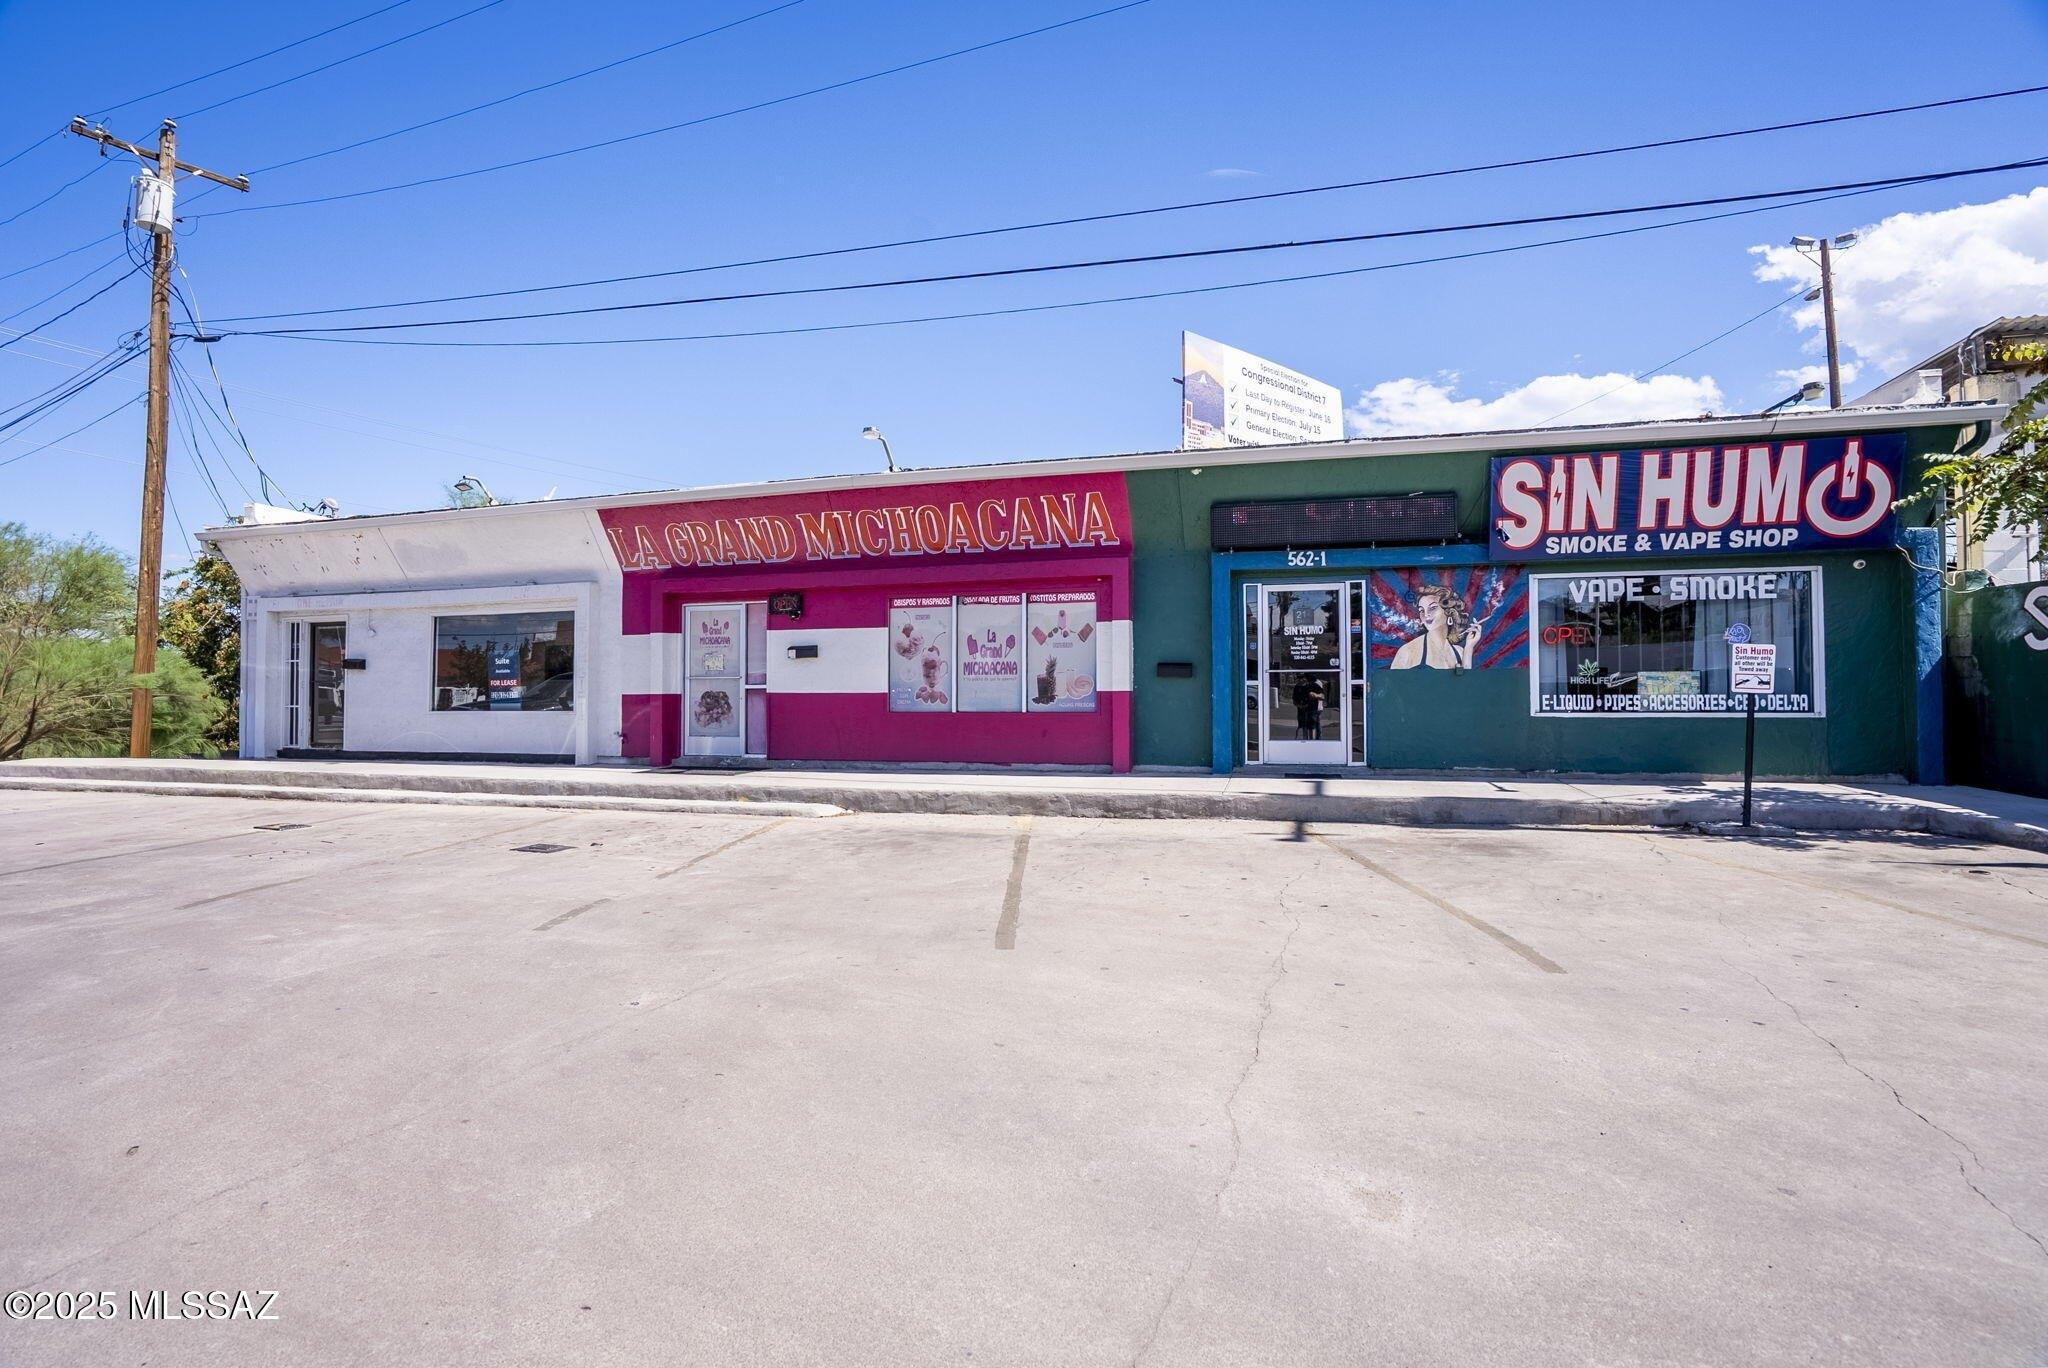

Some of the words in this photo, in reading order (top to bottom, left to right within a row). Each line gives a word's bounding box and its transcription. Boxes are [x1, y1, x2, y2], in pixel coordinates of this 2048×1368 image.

[1260, 364, 1280, 377] Special
[1280, 371, 1301, 384] Election
[1241, 367, 1296, 395] Congressional
[1297, 387, 1322, 404] District
[1322, 396, 1326, 405] 7
[1245, 389, 1260, 400] Last
[1261, 393, 1273, 406] Day
[1273, 398, 1280, 407] to
[1308, 409, 1323, 421] June
[1246, 404, 1270, 420] Primary
[1272, 412, 1296, 427] Election:
[1299, 420, 1312, 434] July
[1314, 425, 1321, 434] 15
[1246, 421, 1272, 436] General
[1497, 456, 1621, 550] SIN
[1638, 441, 1892, 537] HUMO
[607, 526, 671, 572] LA
[665, 516, 797, 567] GRAND
[796, 491, 1121, 561] MICHOACANA
[1545, 534, 1627, 556] SMOKE
[1634, 533, 1652, 552] &
[1660, 531, 1722, 551] VAPE
[1728, 528, 1799, 548] SHOP
[1288, 551, 1327, 567] 562-1
[1058, 592, 1095, 600] PREPARADOS
[1568, 577, 1645, 603] VAPE
[1669, 575, 1778, 601] SMOKE
[918, 598, 922, 606] Y
[922, 598, 950, 606] RASPADOS
[990, 596, 998, 604] DE
[999, 595, 1020, 603] FRUTAS
[987, 629, 996, 643] La
[1284, 626, 1298, 636] SIN
[1300, 626, 1324, 635] HUMO
[1542, 624, 1597, 646] OPEN
[980, 644, 1002, 659] Grand
[1735, 646, 1748, 655] Sin
[1750, 646, 1774, 655] Humo
[963, 661, 1018, 676] MICHOACANA
[1570, 676, 1596, 685] HIGH
[1596, 676, 1610, 685] LIFE
[1542, 694, 1594, 711] E-LIQUID
[1604, 694, 1641, 710] PIPES
[1649, 694, 1726, 710] ACCESORIES
[1768, 694, 1809, 710] DELTA
